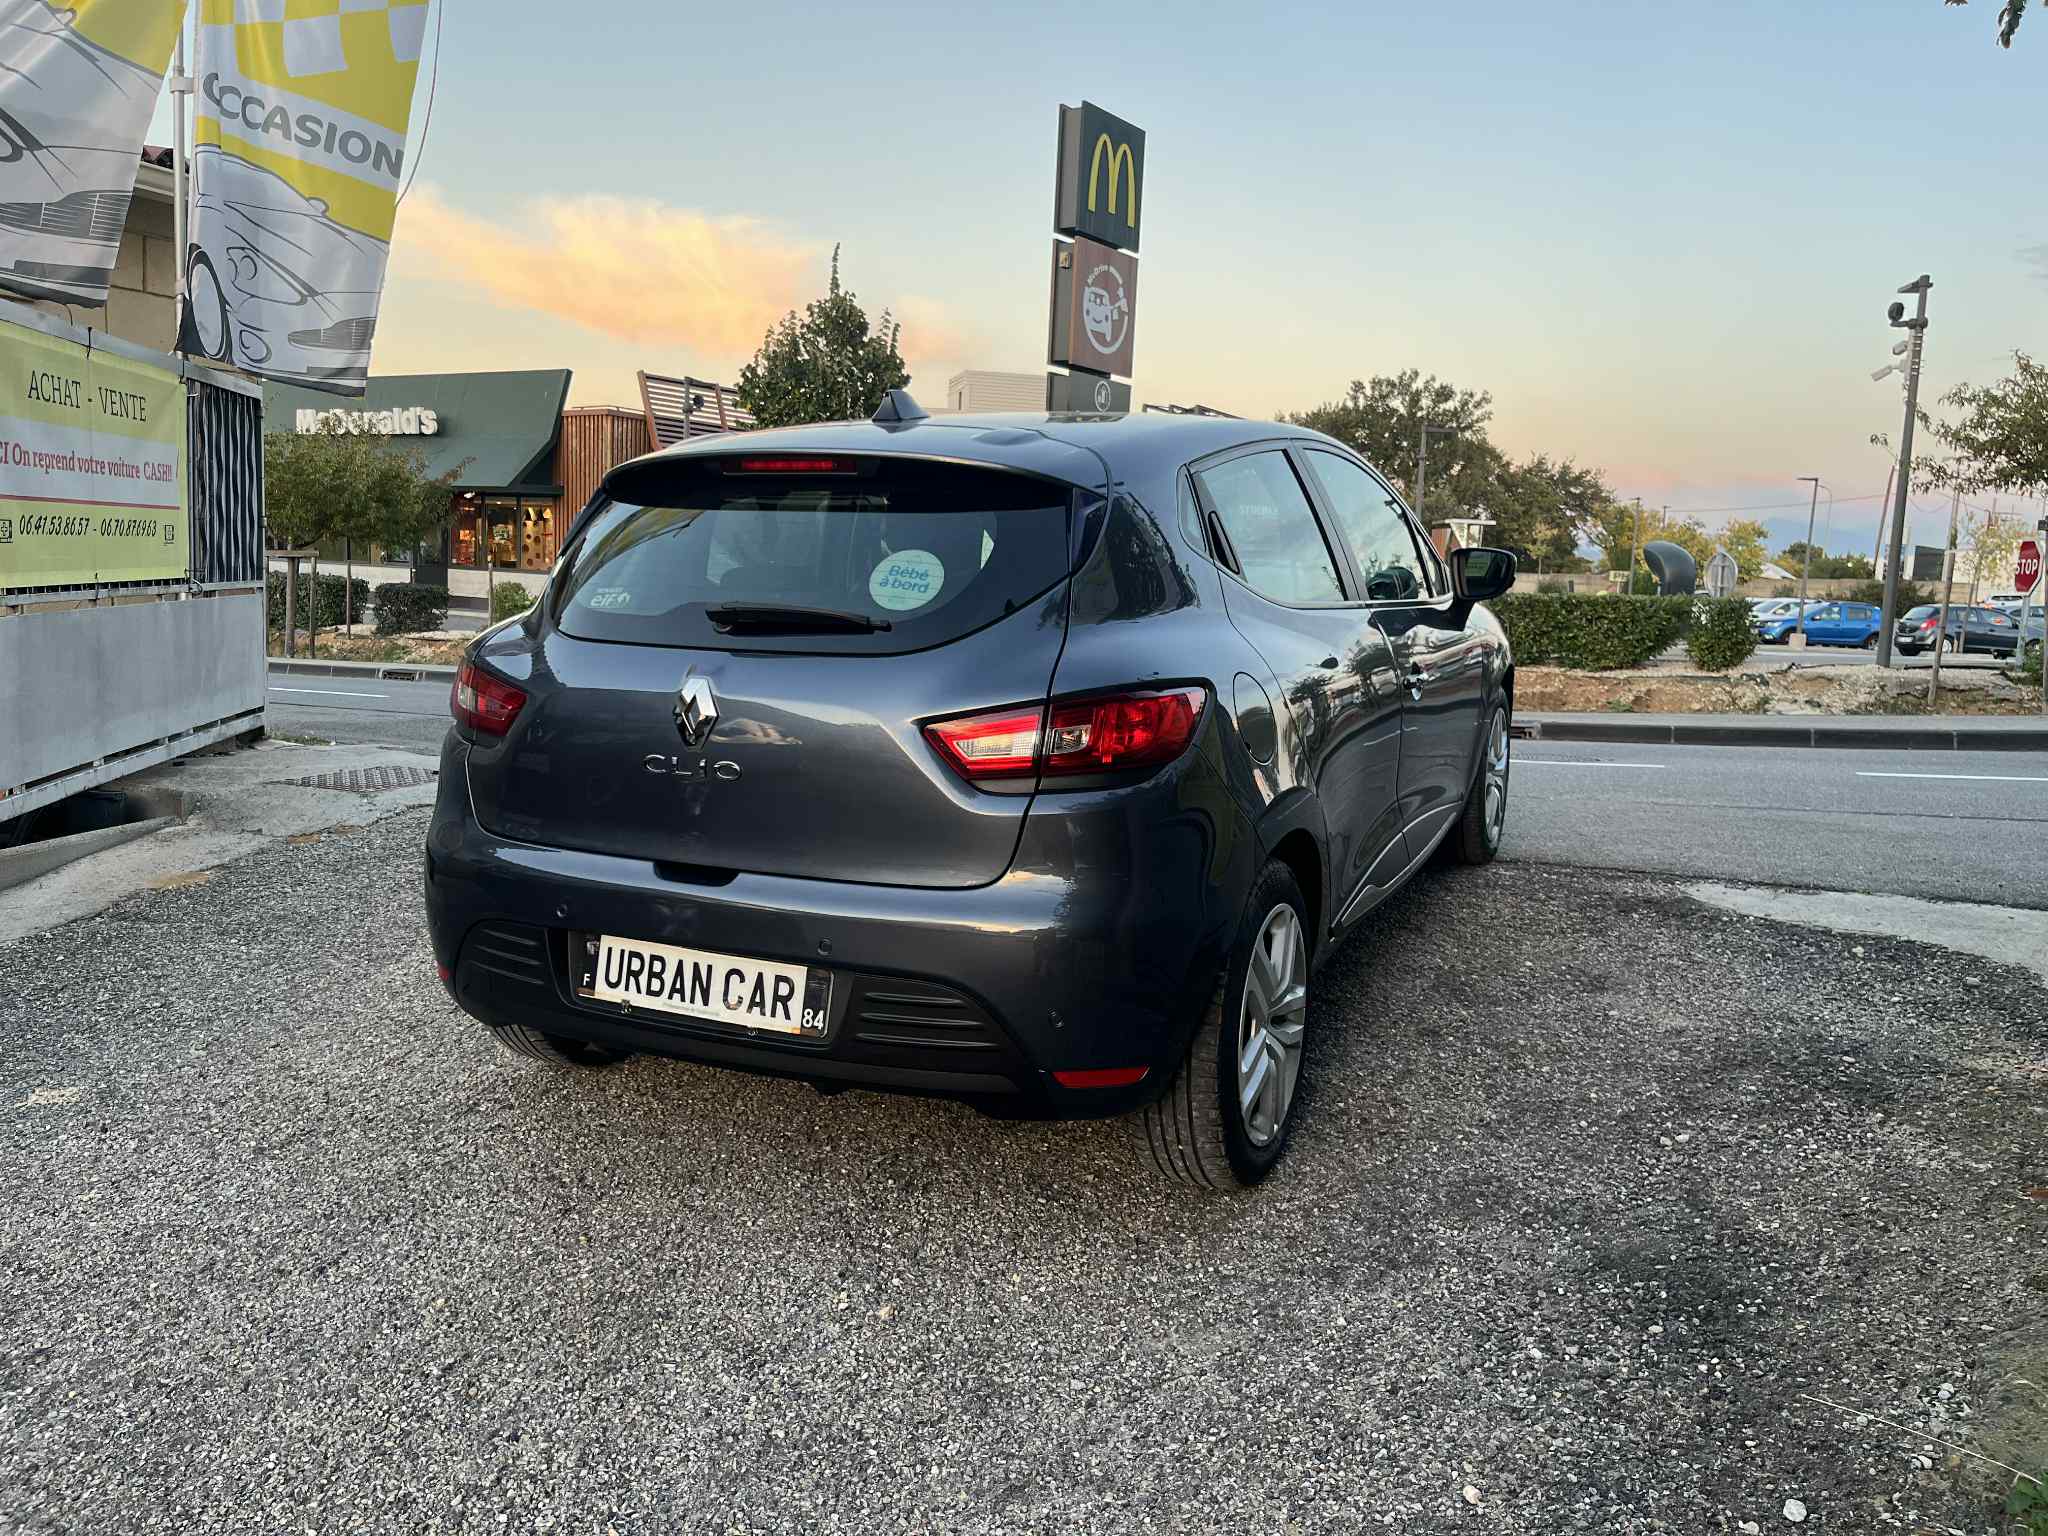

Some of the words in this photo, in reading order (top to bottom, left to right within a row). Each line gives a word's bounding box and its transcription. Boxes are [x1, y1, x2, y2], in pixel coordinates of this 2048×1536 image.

[28, 370, 81, 408] ACHAT
[98, 387, 147, 422] VENTE
[13, 442, 31, 467] On
[32, 451, 75, 474] reprend
[77, 458, 105, 475] votre
[107, 457, 140, 479] voiture
[888, 564, 929, 581] Bébé
[2016, 558, 2038, 575] STOP
[891, 578, 930, 593] bord
[644, 754, 742, 780] CLIO
[583, 973, 591, 986] F
[604, 946, 713, 1007] URBAN
[722, 968, 796, 1021] CAR
[802, 1008, 824, 1031] 84
